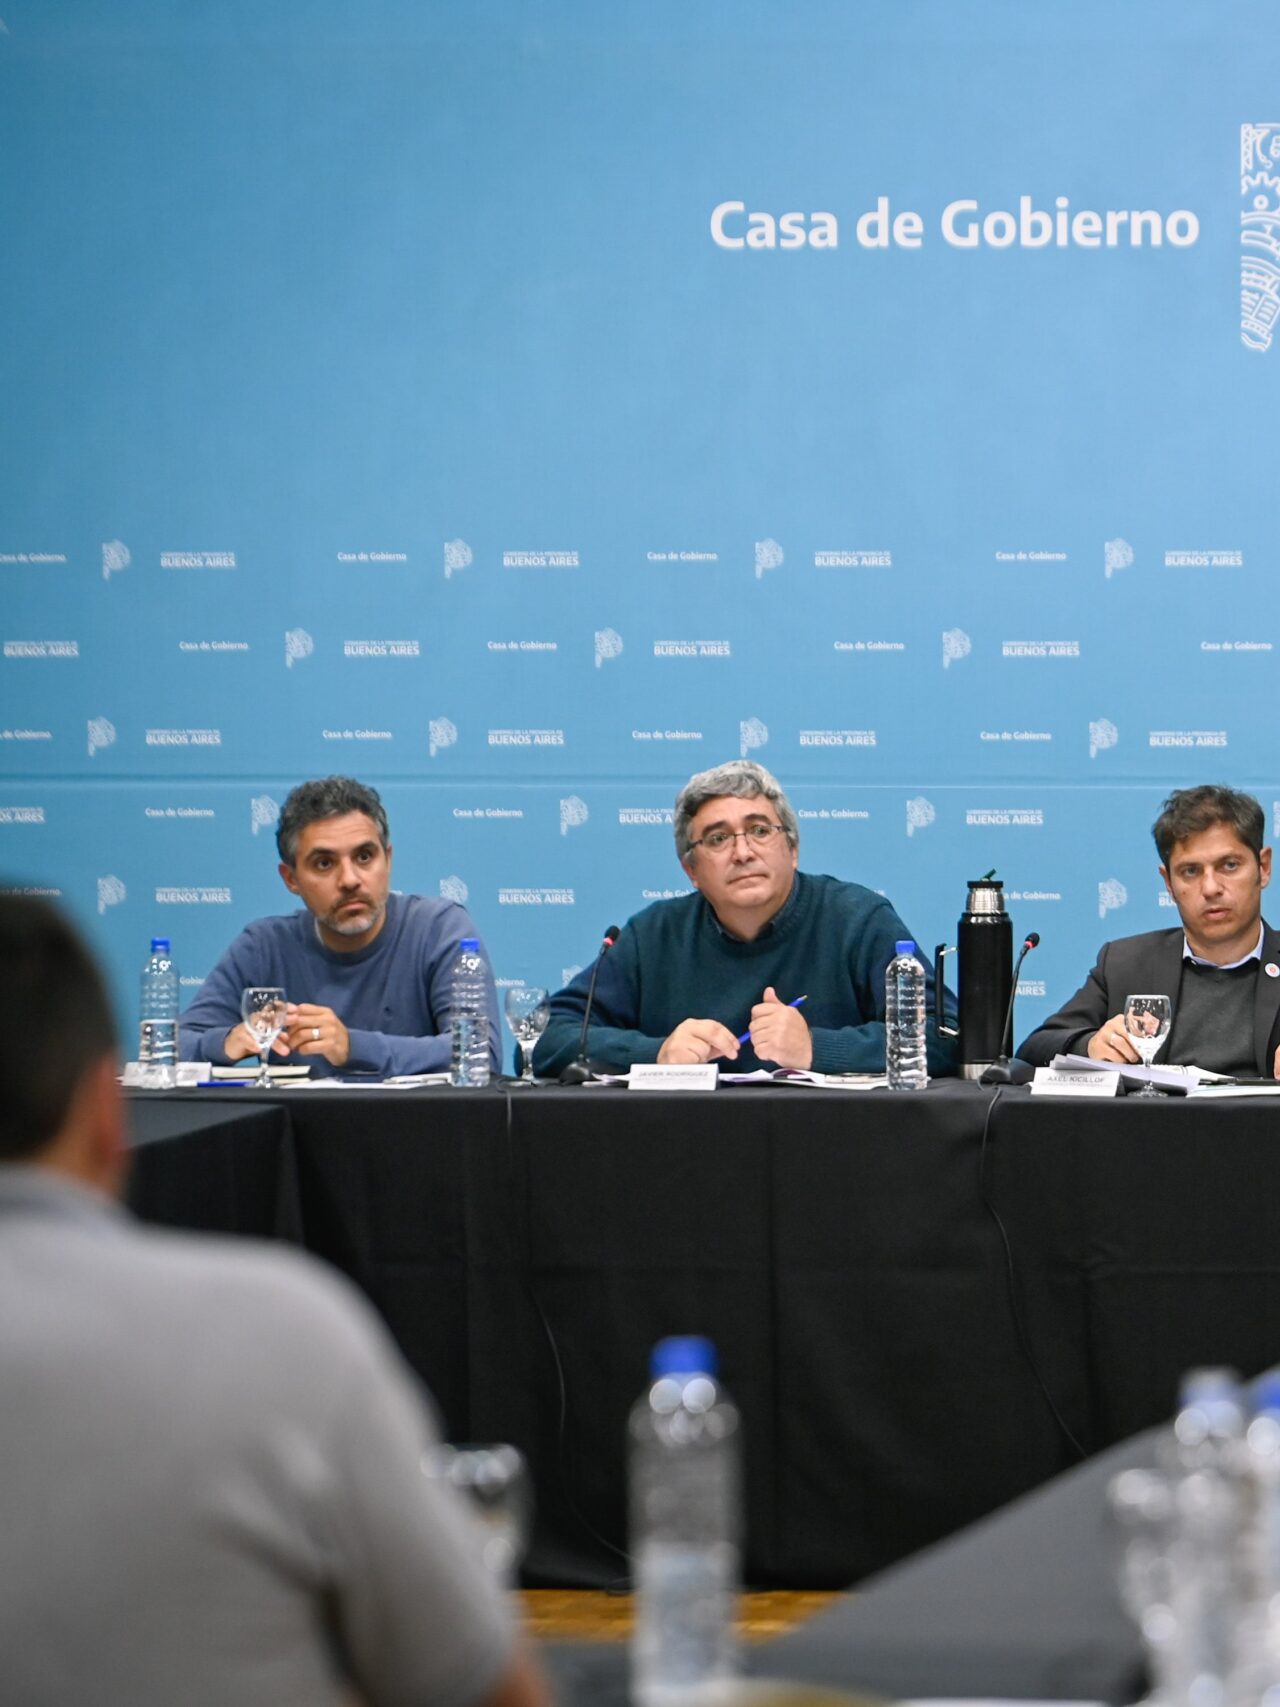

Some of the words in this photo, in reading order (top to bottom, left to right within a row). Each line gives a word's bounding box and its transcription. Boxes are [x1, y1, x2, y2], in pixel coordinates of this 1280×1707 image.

[710, 202, 838, 248] Casa
[857, 197, 924, 248] de
[942, 196, 1200, 248] Gobierno
[358, 552, 368, 561] de
[668, 552, 678, 560] de
[1016, 551, 1027, 560] de
[503, 556, 546, 566] BUENOS
[548, 556, 579, 566] AIRES
[815, 556, 858, 566] BUENOS
[860, 556, 891, 566] AIRES
[1164, 556, 1208, 566] BUENOS
[1211, 556, 1242, 566] AIRES
[344, 645, 386, 656] BUENOS
[389, 645, 419, 656] AIRES
[508, 641, 518, 650] de
[654, 645, 697, 656] BUENOS
[699, 645, 730, 656] AIRES
[855, 641, 865, 650] de
[1222, 641, 1232, 650] de
[1002, 646, 1046, 656] BUENOS
[1048, 646, 1079, 656] AIRES
[488, 734, 531, 745] BUENOS
[533, 734, 564, 745] AIRES
[653, 730, 663, 739] de
[1001, 731, 1012, 740] de
[800, 735, 843, 745] BUENOS
[845, 735, 876, 745] AIRES
[1149, 736, 1193, 746] BUENOS
[1196, 736, 1227, 746] AIRES
[474, 808, 484, 816] de
[819, 809, 829, 818] de
[619, 813, 663, 824] BUENOS
[966, 814, 1009, 824] BUENOS
[1011, 814, 1042, 824] AIRES
[498, 893, 541, 903] BUENOS
[543, 893, 574, 903] AIRES
